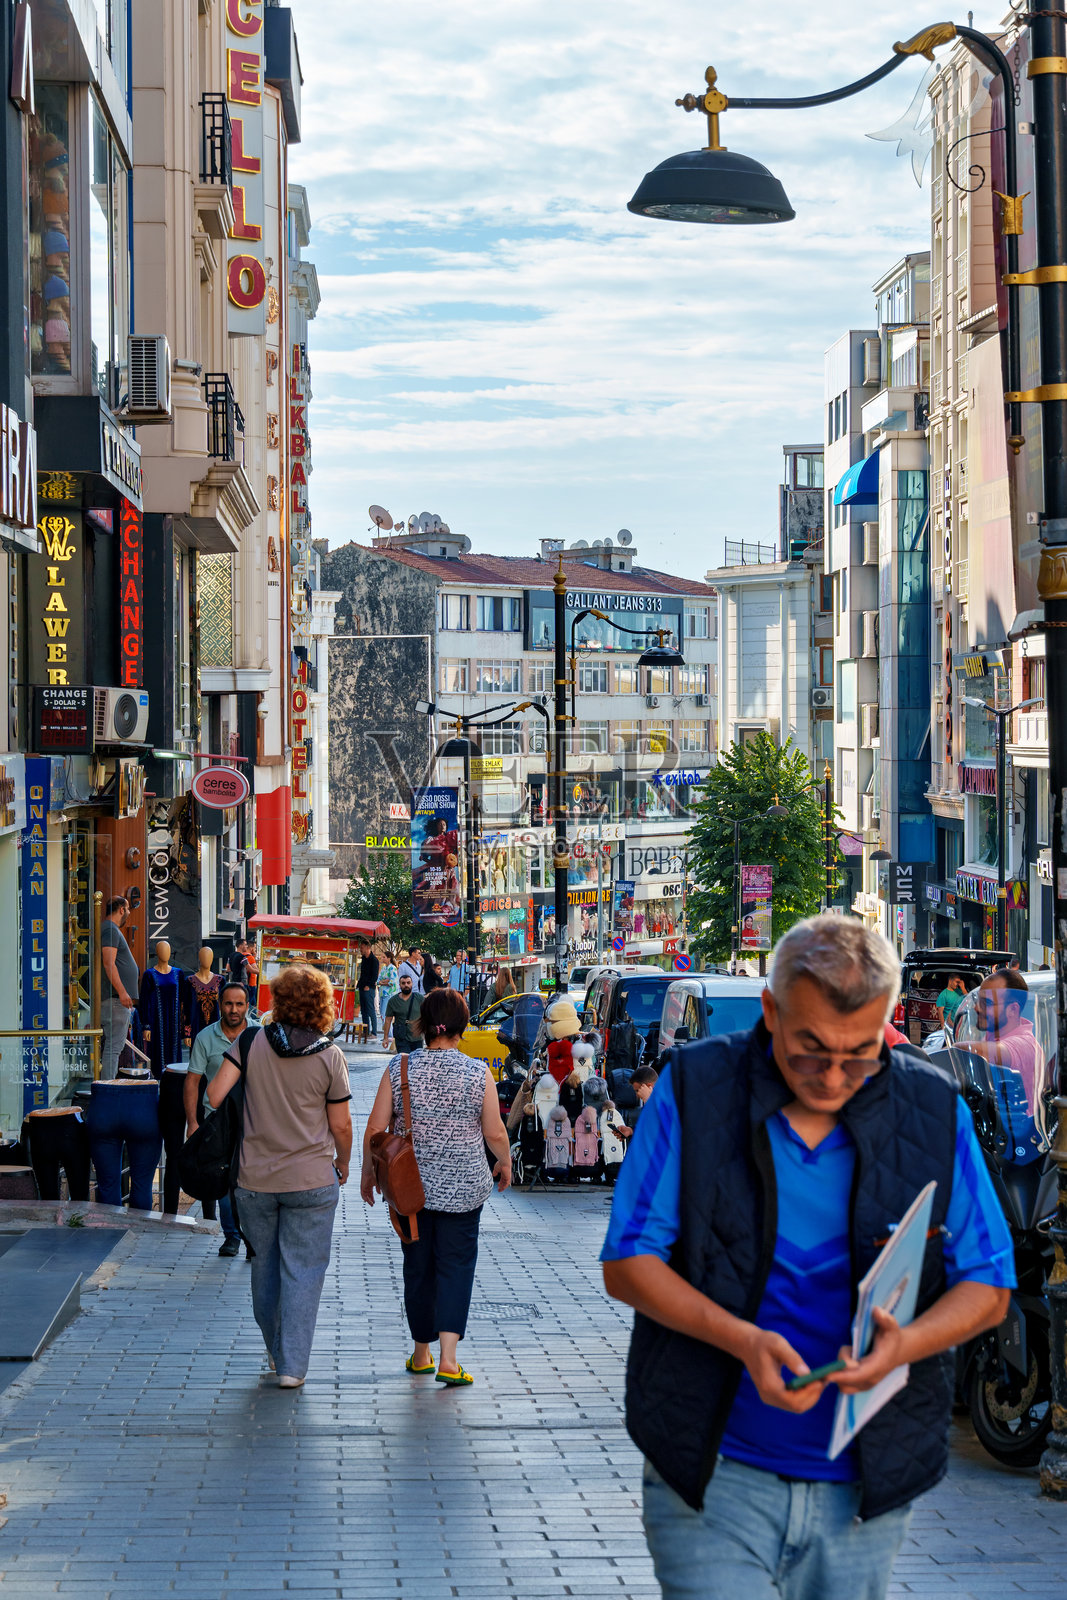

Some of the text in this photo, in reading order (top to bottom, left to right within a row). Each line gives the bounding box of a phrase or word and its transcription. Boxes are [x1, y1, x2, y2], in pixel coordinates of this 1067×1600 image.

[566, 592, 663, 612] GALLANT JEANS 313
[42, 689, 88, 698] CHANGE
[203, 778, 237, 790] ceres
[439, 801, 457, 809] SHOW
[365, 836, 407, 848] BLACK
[567, 889, 611, 905] ILLIONRE
[31, 919, 44, 991] BLUE
